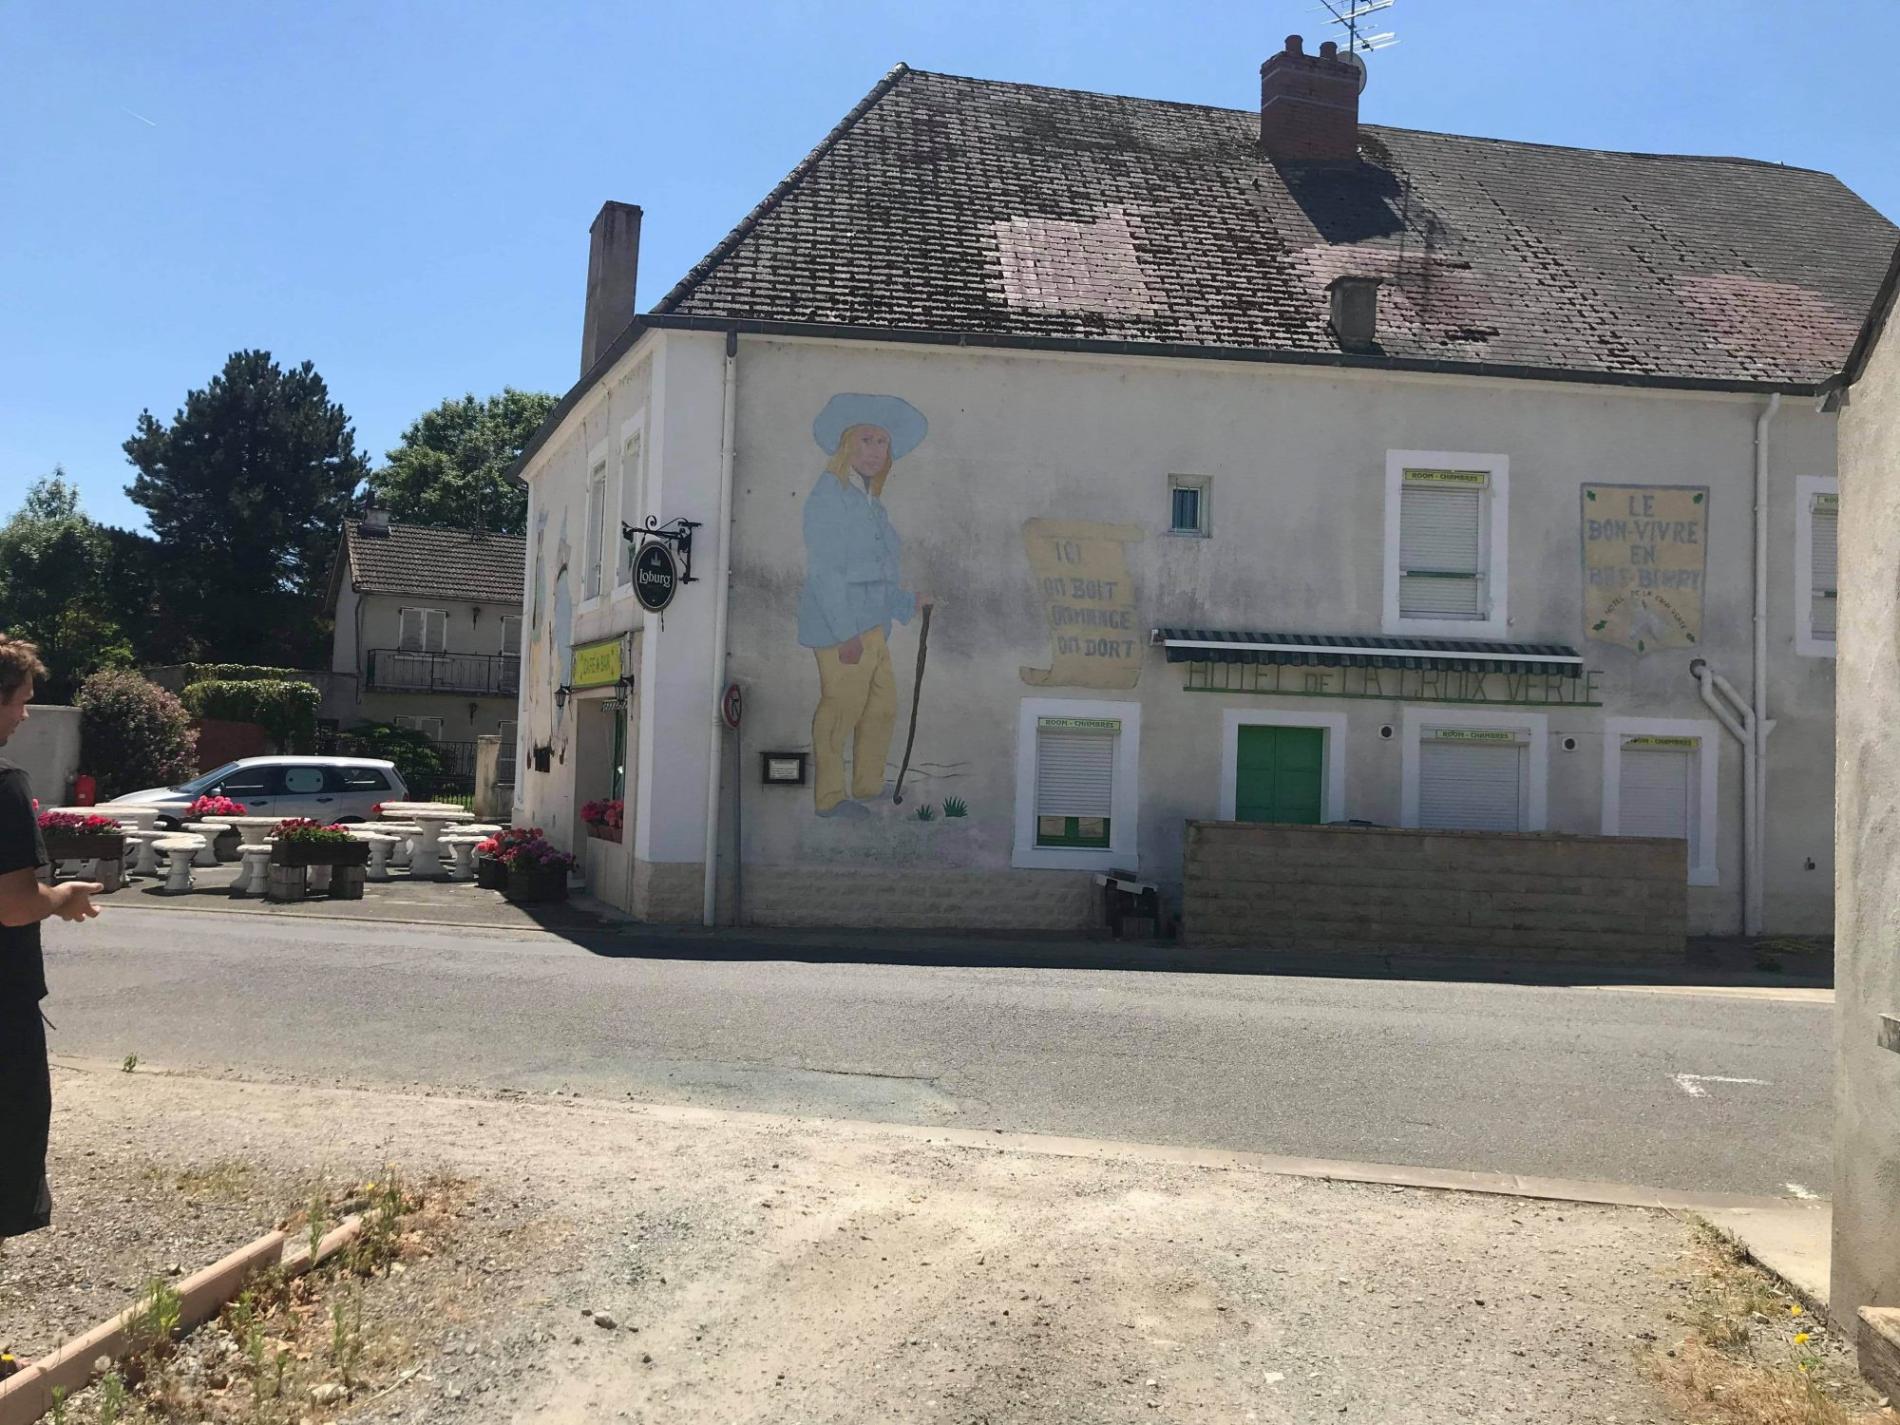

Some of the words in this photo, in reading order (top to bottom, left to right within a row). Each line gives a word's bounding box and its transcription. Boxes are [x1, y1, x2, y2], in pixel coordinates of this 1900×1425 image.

[1628, 494, 1655, 517] LE
[1630, 545, 1656, 565] EN
[639, 568, 671, 588] Loburg
[1084, 638, 1137, 659] DORT
